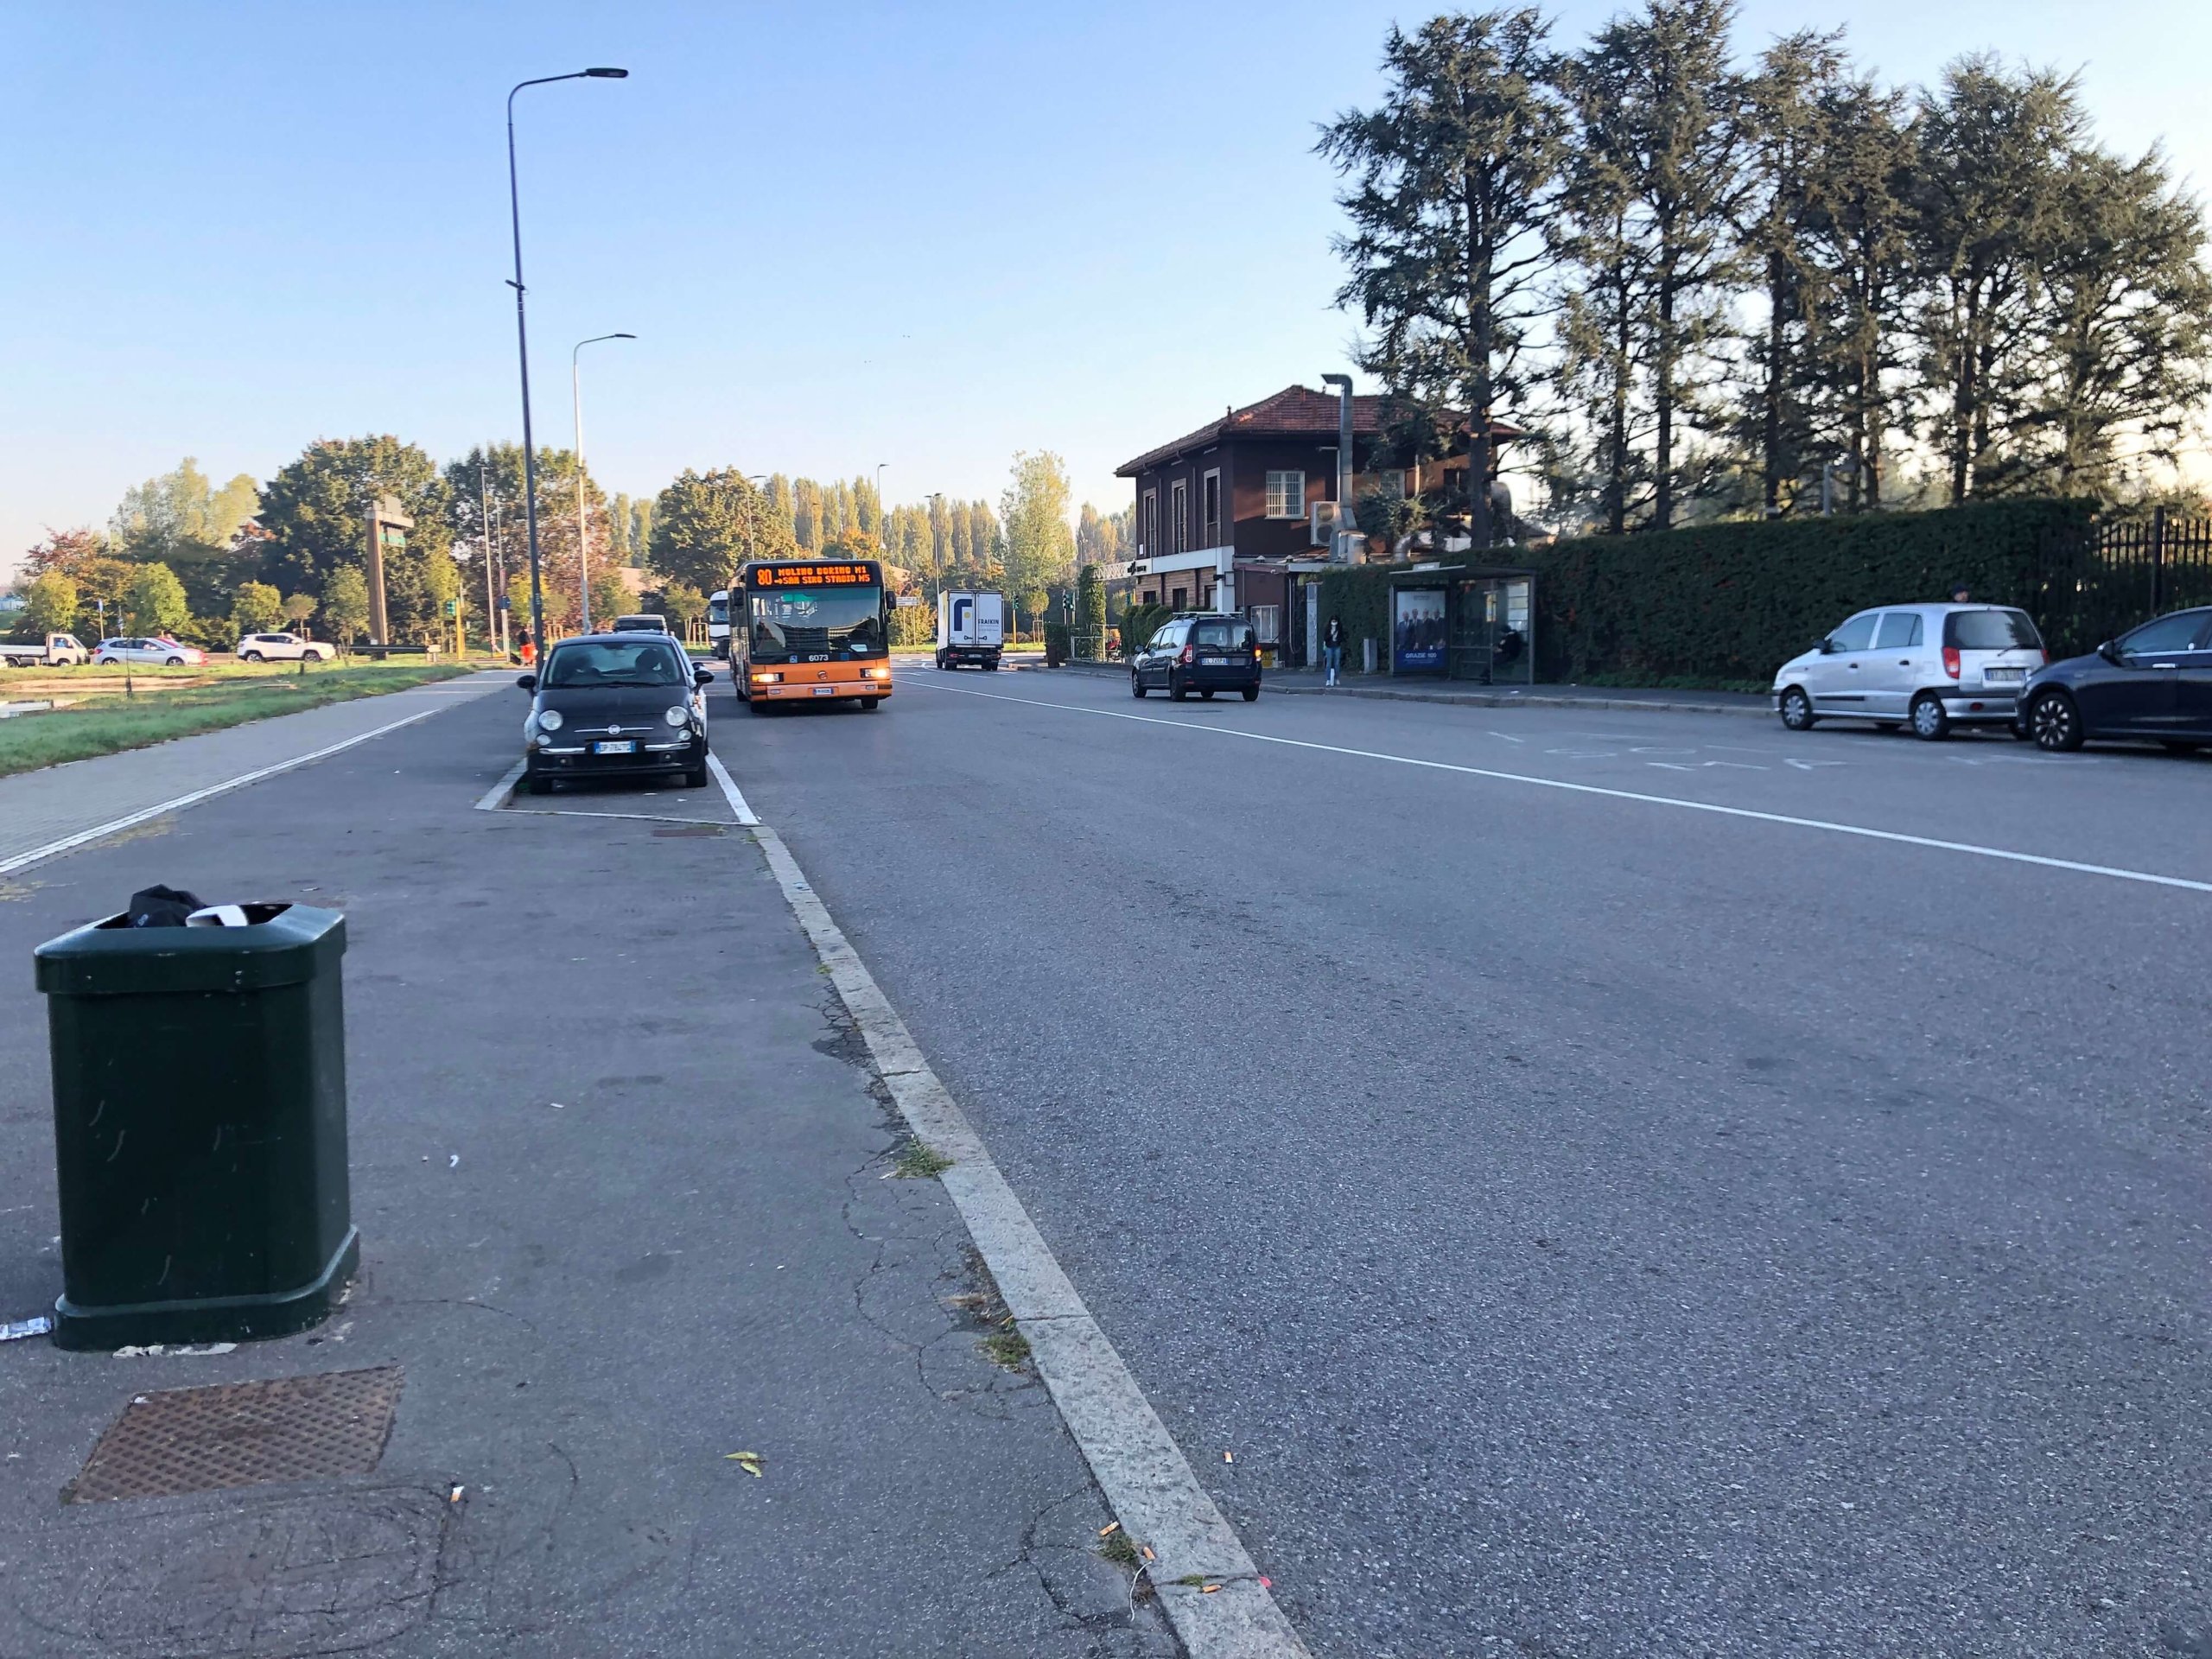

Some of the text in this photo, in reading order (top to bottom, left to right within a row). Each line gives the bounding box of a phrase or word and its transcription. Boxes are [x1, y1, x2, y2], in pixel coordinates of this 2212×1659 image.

[778, 568, 813, 576] MOLINO
[855, 565, 867, 574] M1
[757, 569, 772, 585] 80
[783, 574, 871, 585] SAN SIRO STADIO M5
